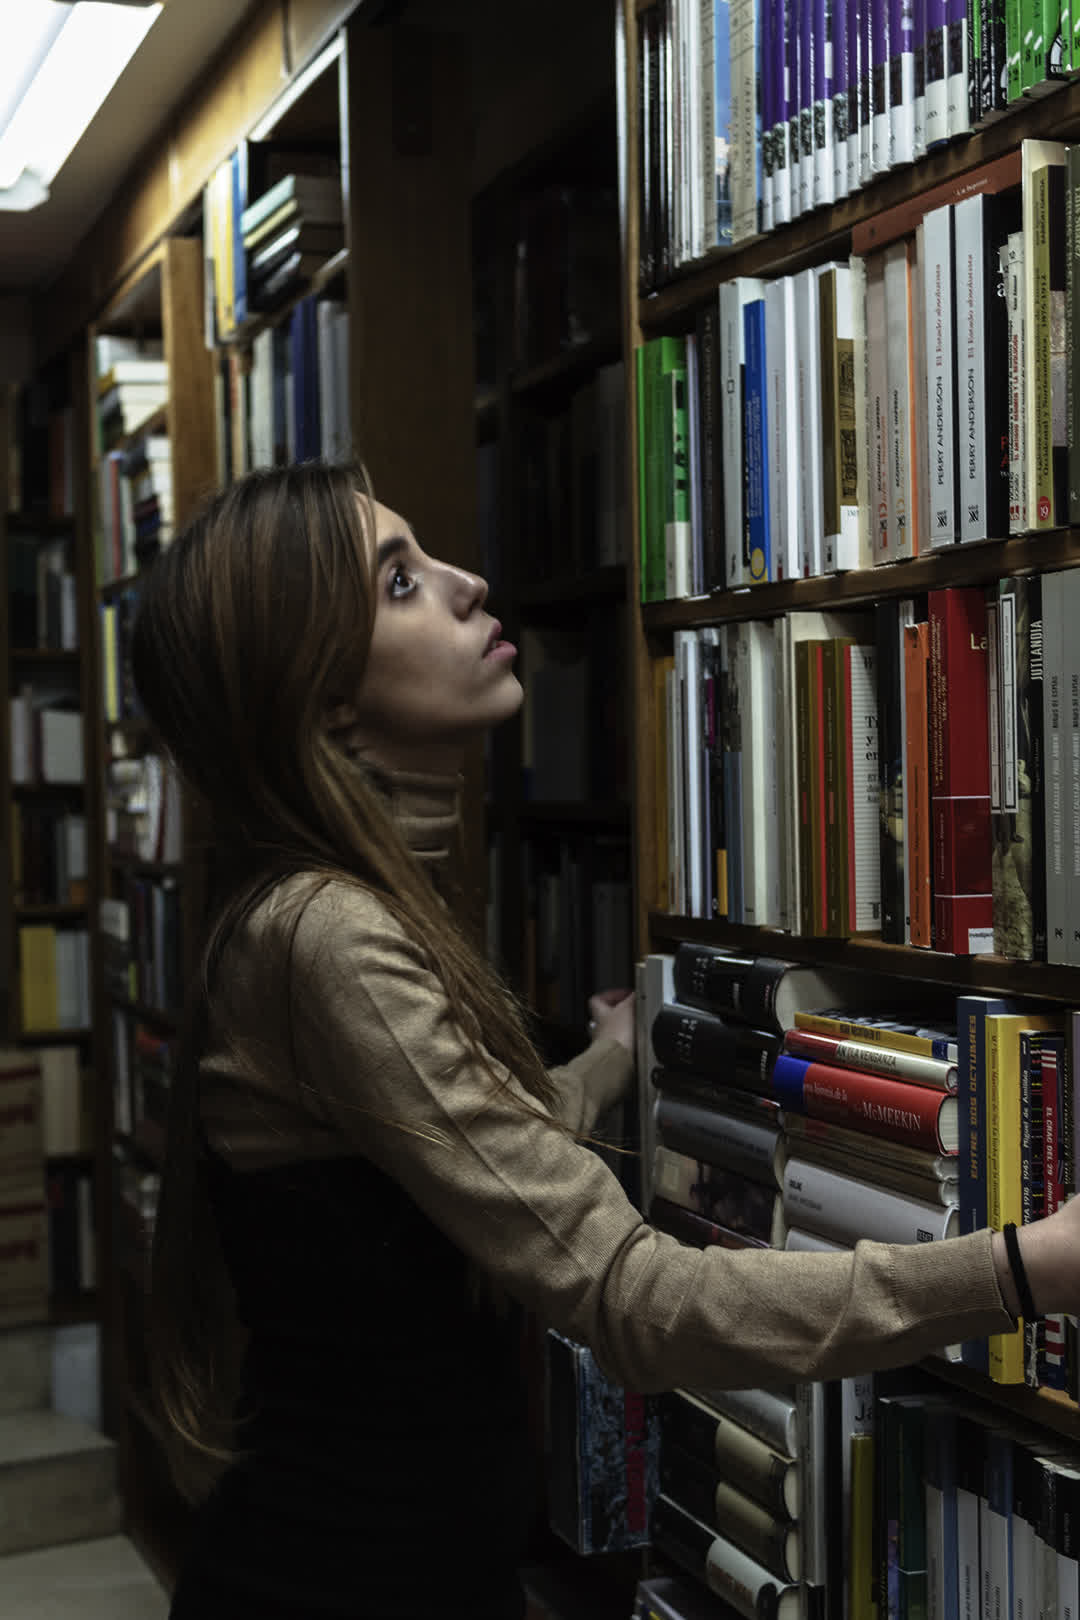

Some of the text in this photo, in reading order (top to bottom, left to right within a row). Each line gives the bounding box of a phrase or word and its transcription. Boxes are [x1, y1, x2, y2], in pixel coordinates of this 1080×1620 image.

[935, 376, 944, 448] ANDERSON
[967, 368, 976, 440] ANDERSON
[936, 452, 944, 486] PERRY
[968, 443, 976, 480] PERRY
[1029, 619, 1044, 681] JUTLANDIA
[968, 1015, 978, 1092] OCTUBRES
[863, 1101, 921, 1131] McMEEKIN
[1046, 1106, 1054, 1117] EL
[1022, 1121, 1031, 1149] Miguel
[1046, 1118, 1054, 1143] CRAC
[969, 1131, 979, 1180] ENTRE
[1046, 1144, 1055, 1161] DEL
